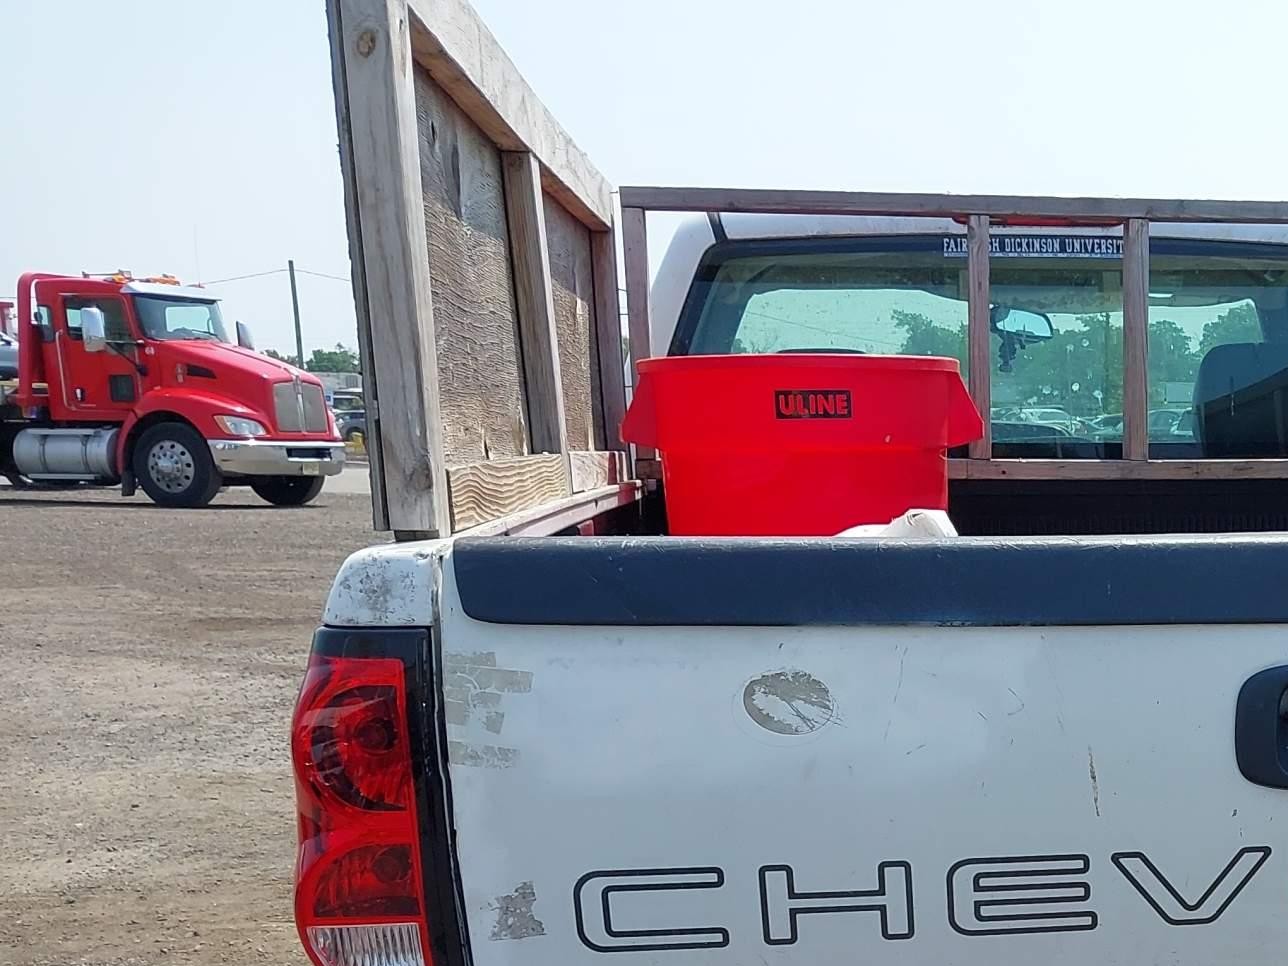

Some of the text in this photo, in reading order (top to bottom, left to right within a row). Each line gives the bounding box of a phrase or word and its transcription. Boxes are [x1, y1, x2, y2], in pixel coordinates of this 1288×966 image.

[943, 237, 1124, 254] FAIRH DICKINSON UNIVERSIT
[779, 394, 849, 416] ULINE
